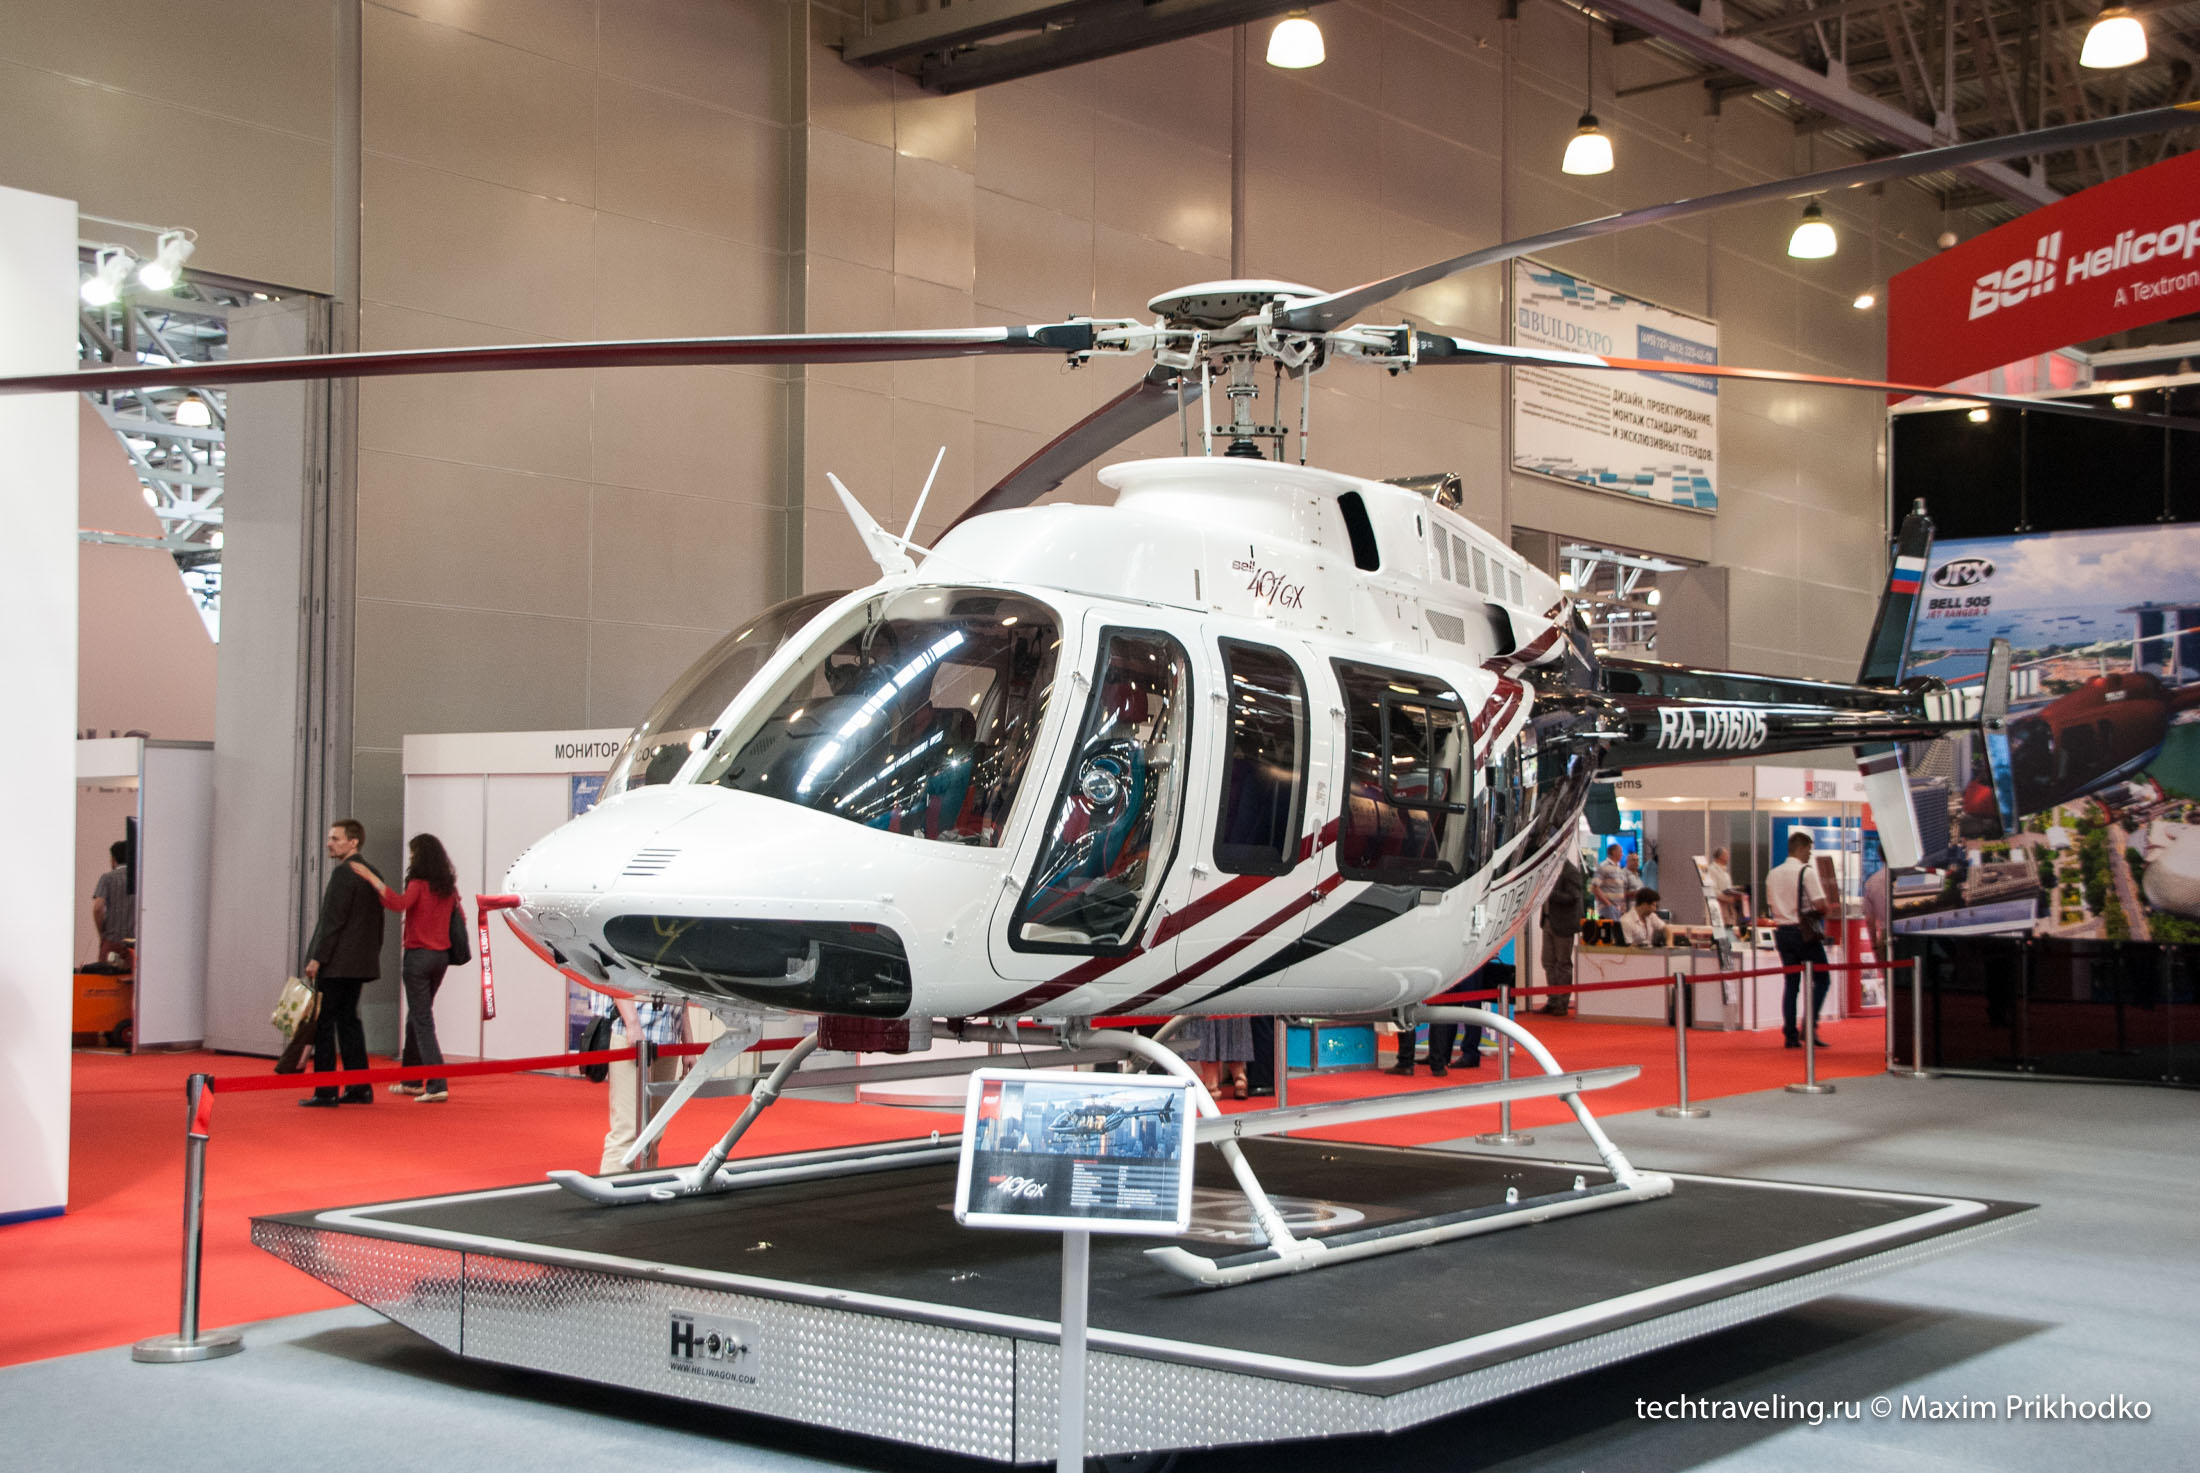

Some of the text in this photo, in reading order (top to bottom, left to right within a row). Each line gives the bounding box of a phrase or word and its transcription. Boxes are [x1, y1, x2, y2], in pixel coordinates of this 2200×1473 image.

[1968, 230, 2063, 322] Bell
[2113, 271, 2199, 308] A Textron
[1531, 311, 1612, 355] BUILDEXPO
[1613, 407, 1698, 440] МОНТАЖ СТАНДАРТНЫХ
[1612, 427, 1618, 438] И
[1619, 428, 1680, 454] ЭКСКЛЮЗИВНЫХ
[1937, 561, 1989, 586] JRX
[1926, 609, 1942, 619] JET
[1944, 608, 1979, 618] RANGER
[1929, 595, 1991, 610] BELL 505
[1656, 706, 1768, 750] RA-01605
[555, 742, 620, 760] МОНИТОР
[670, 1362, 756, 1383] WWW.HELIWAGON.COM
